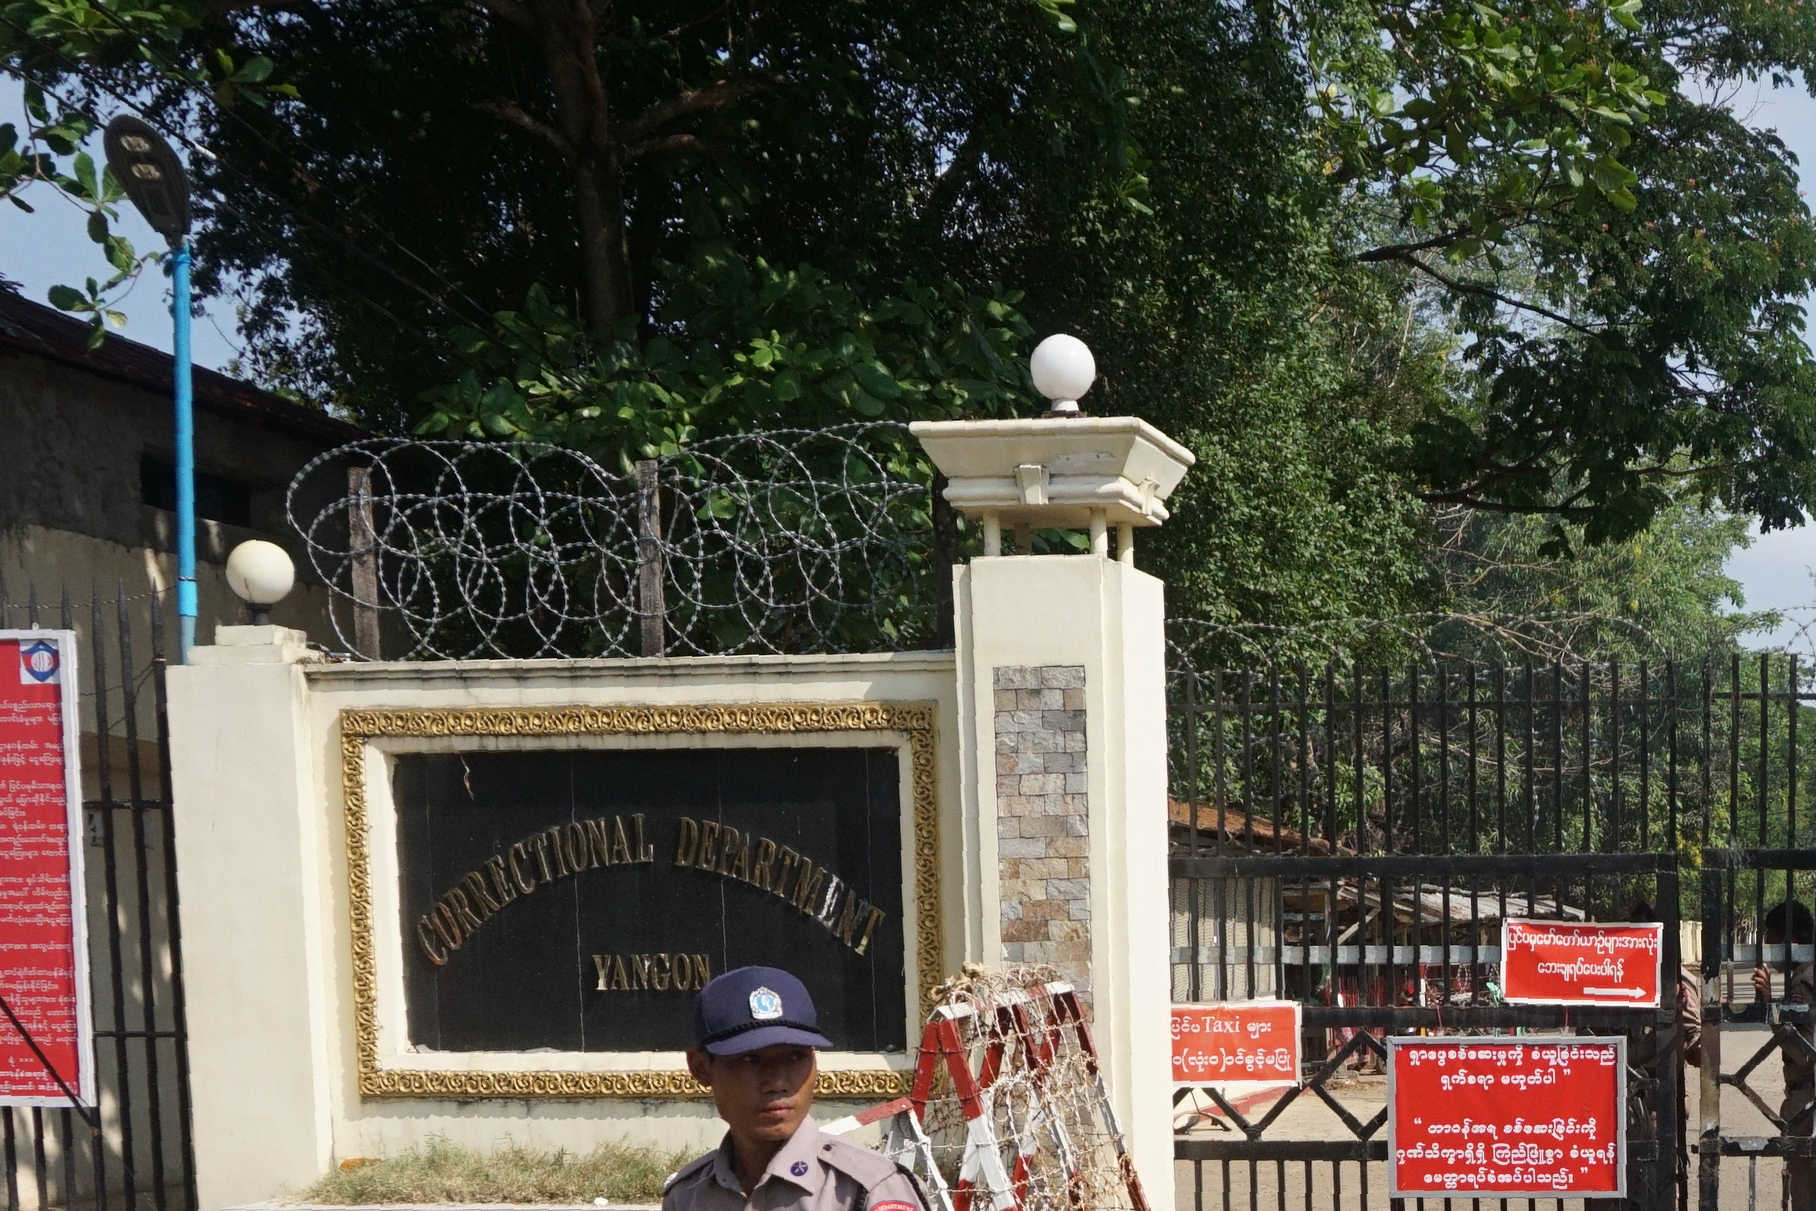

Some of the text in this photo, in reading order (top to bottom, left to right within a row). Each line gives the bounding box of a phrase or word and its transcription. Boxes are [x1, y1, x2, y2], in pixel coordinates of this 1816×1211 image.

[417, 813, 887, 966] CORRECTIONAL DEPARTMENT
[592, 952, 711, 991] YANGON
[1247, 1022, 1271, 1039] များ
